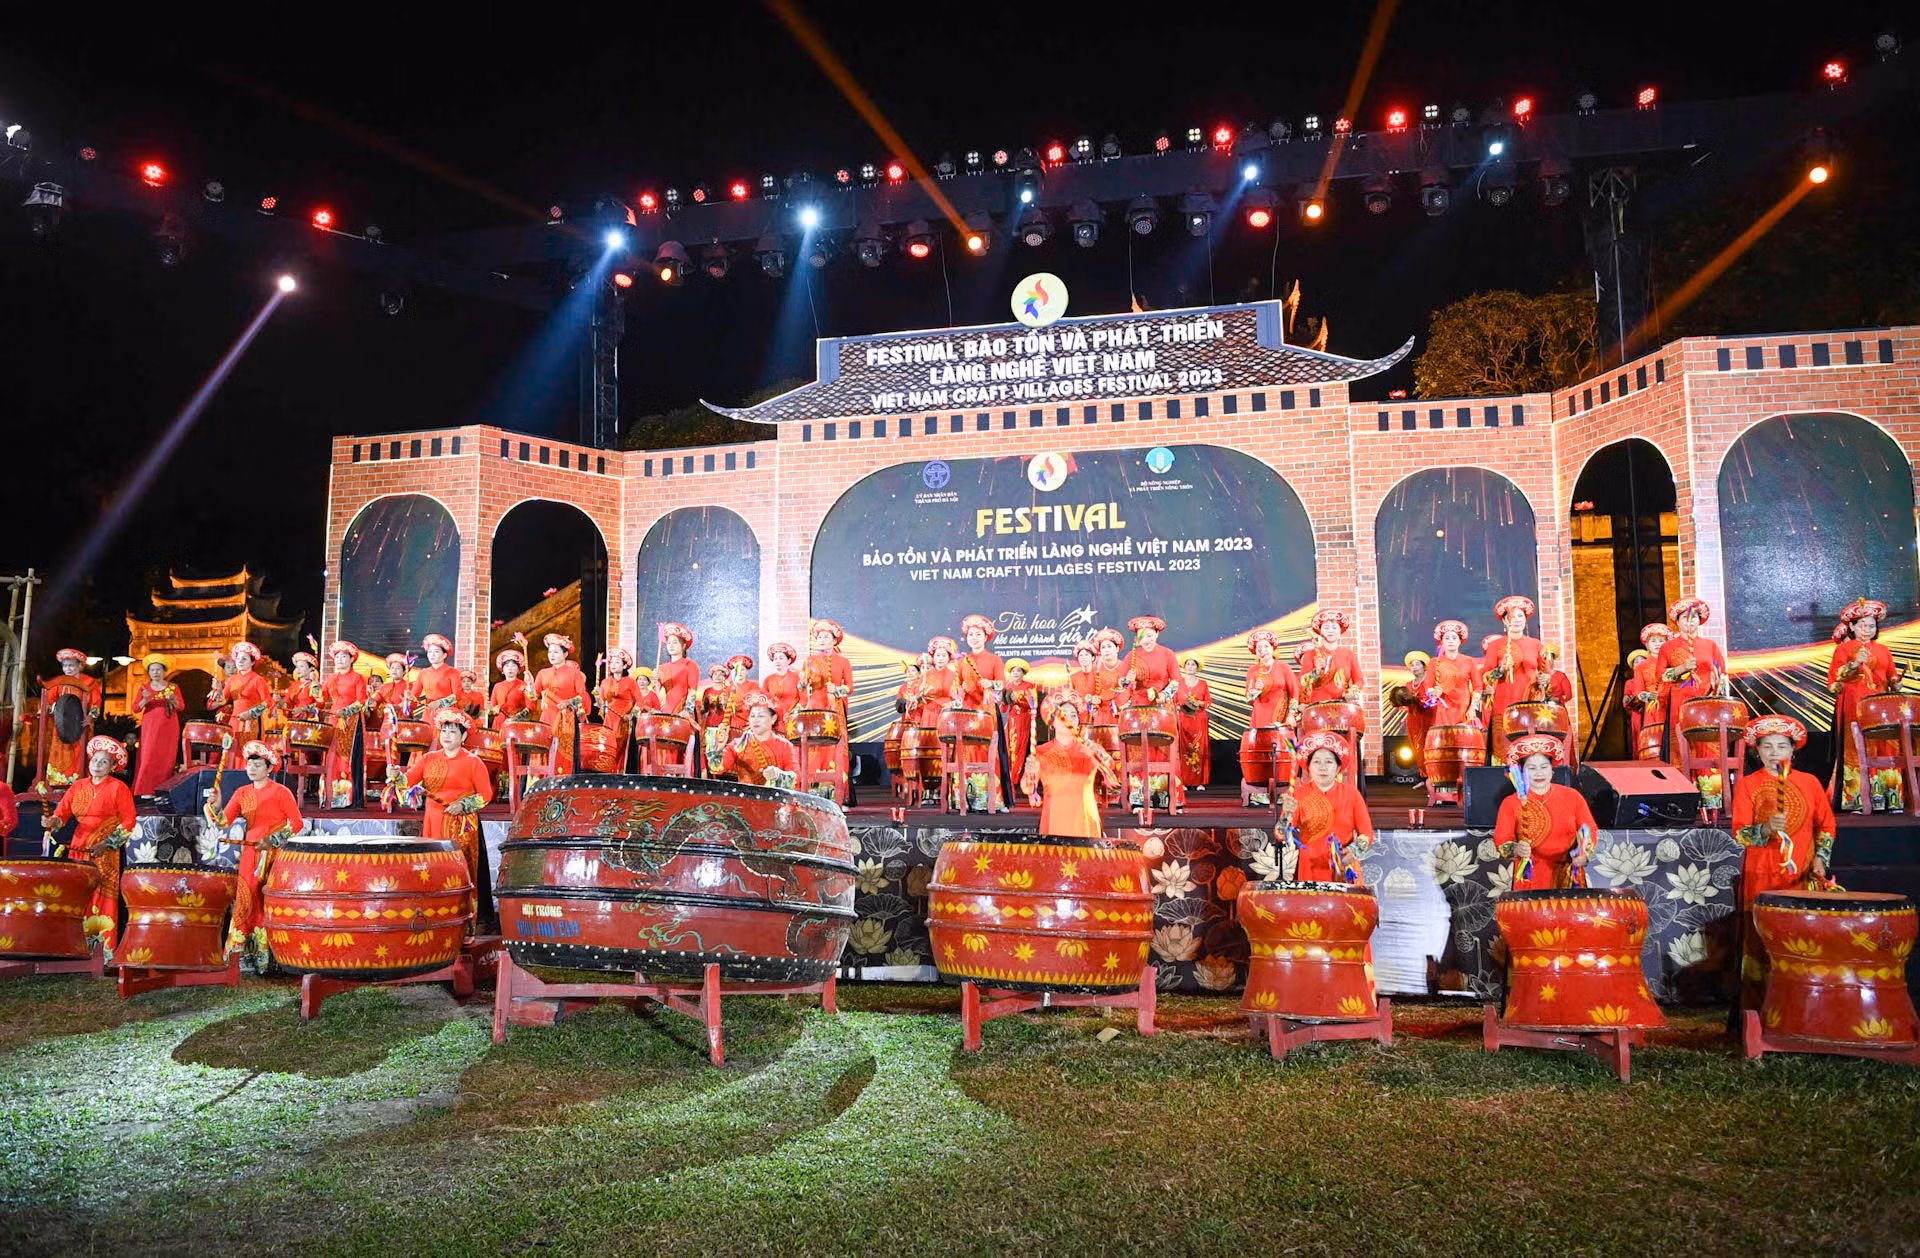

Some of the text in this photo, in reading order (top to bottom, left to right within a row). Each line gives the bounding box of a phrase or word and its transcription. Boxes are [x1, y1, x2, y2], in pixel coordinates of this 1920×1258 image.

[866, 313, 1224, 366] FESTIVAL BẢO TỒN VÀ PHÁT TRIỂN
[929, 350, 1156, 385] LÀNG NGHỀ VIỆT NAM
[871, 368, 1223, 409] VIET NAM CRAFT VILLAGES FESTIVAL 2023
[976, 502, 1126, 538] FESTIVAL
[862, 536, 1253, 567] BẢO TỒN VÀ PHÁT TRIỂN LÀNG NGHỀ VIỆT NAM 2023
[910, 558, 1201, 581] VIET NAM CRAFT VILLAGES FESTIVAL 2023
[993, 611, 1057, 632] Tài hoa
[1056, 626, 1083, 648] giá
[1020, 649, 1032, 657] ARE
[1032, 648, 1073, 657] TRANSFORMED
